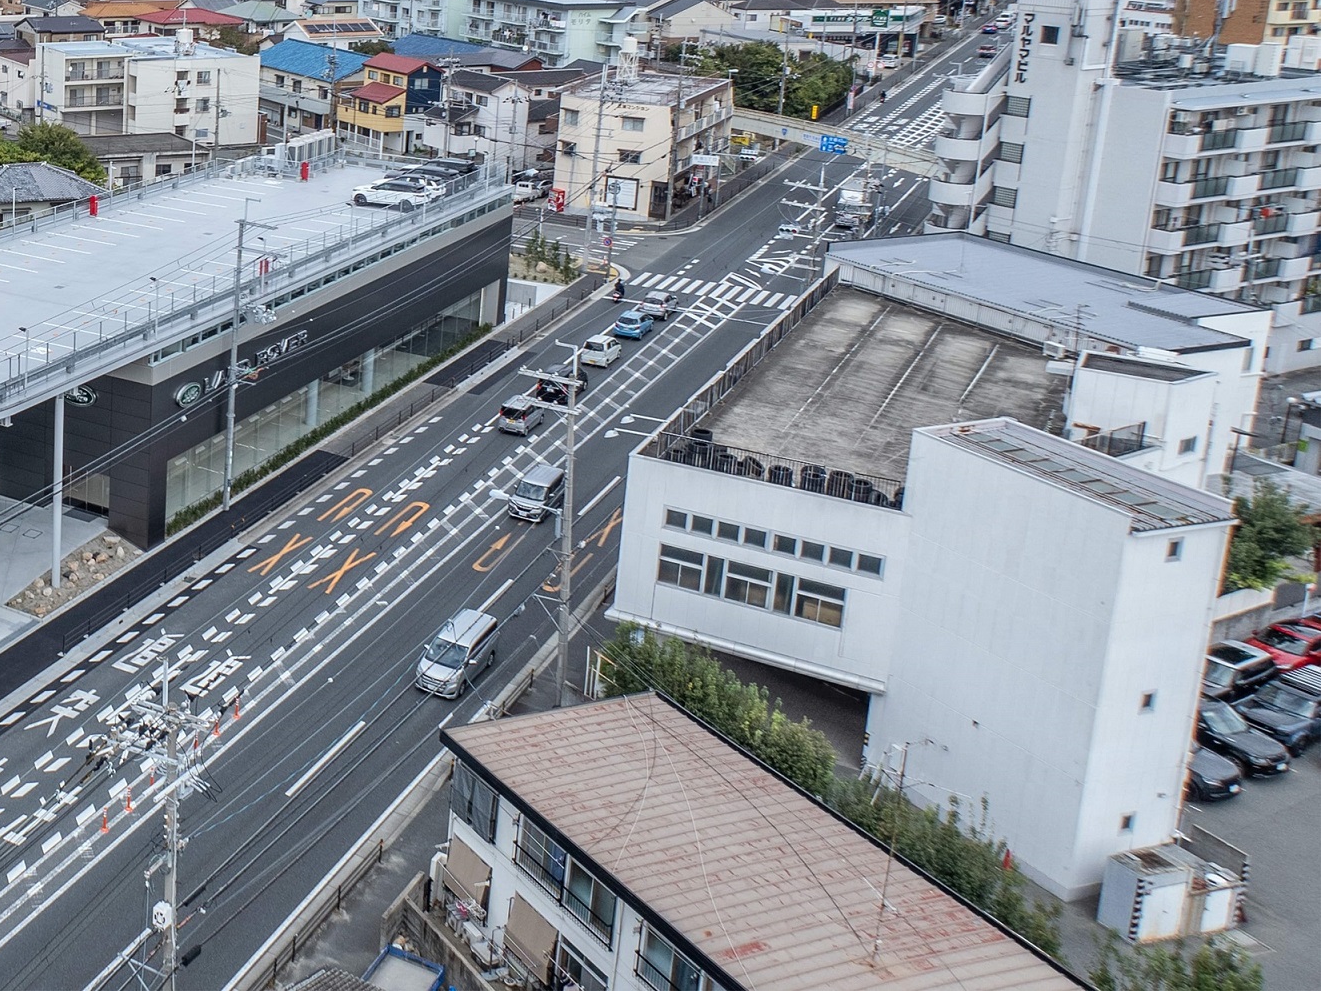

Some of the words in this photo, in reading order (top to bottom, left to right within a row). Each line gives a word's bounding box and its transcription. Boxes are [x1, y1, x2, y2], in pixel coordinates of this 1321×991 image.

[1014, 13, 1035, 84] マルヤマビル
